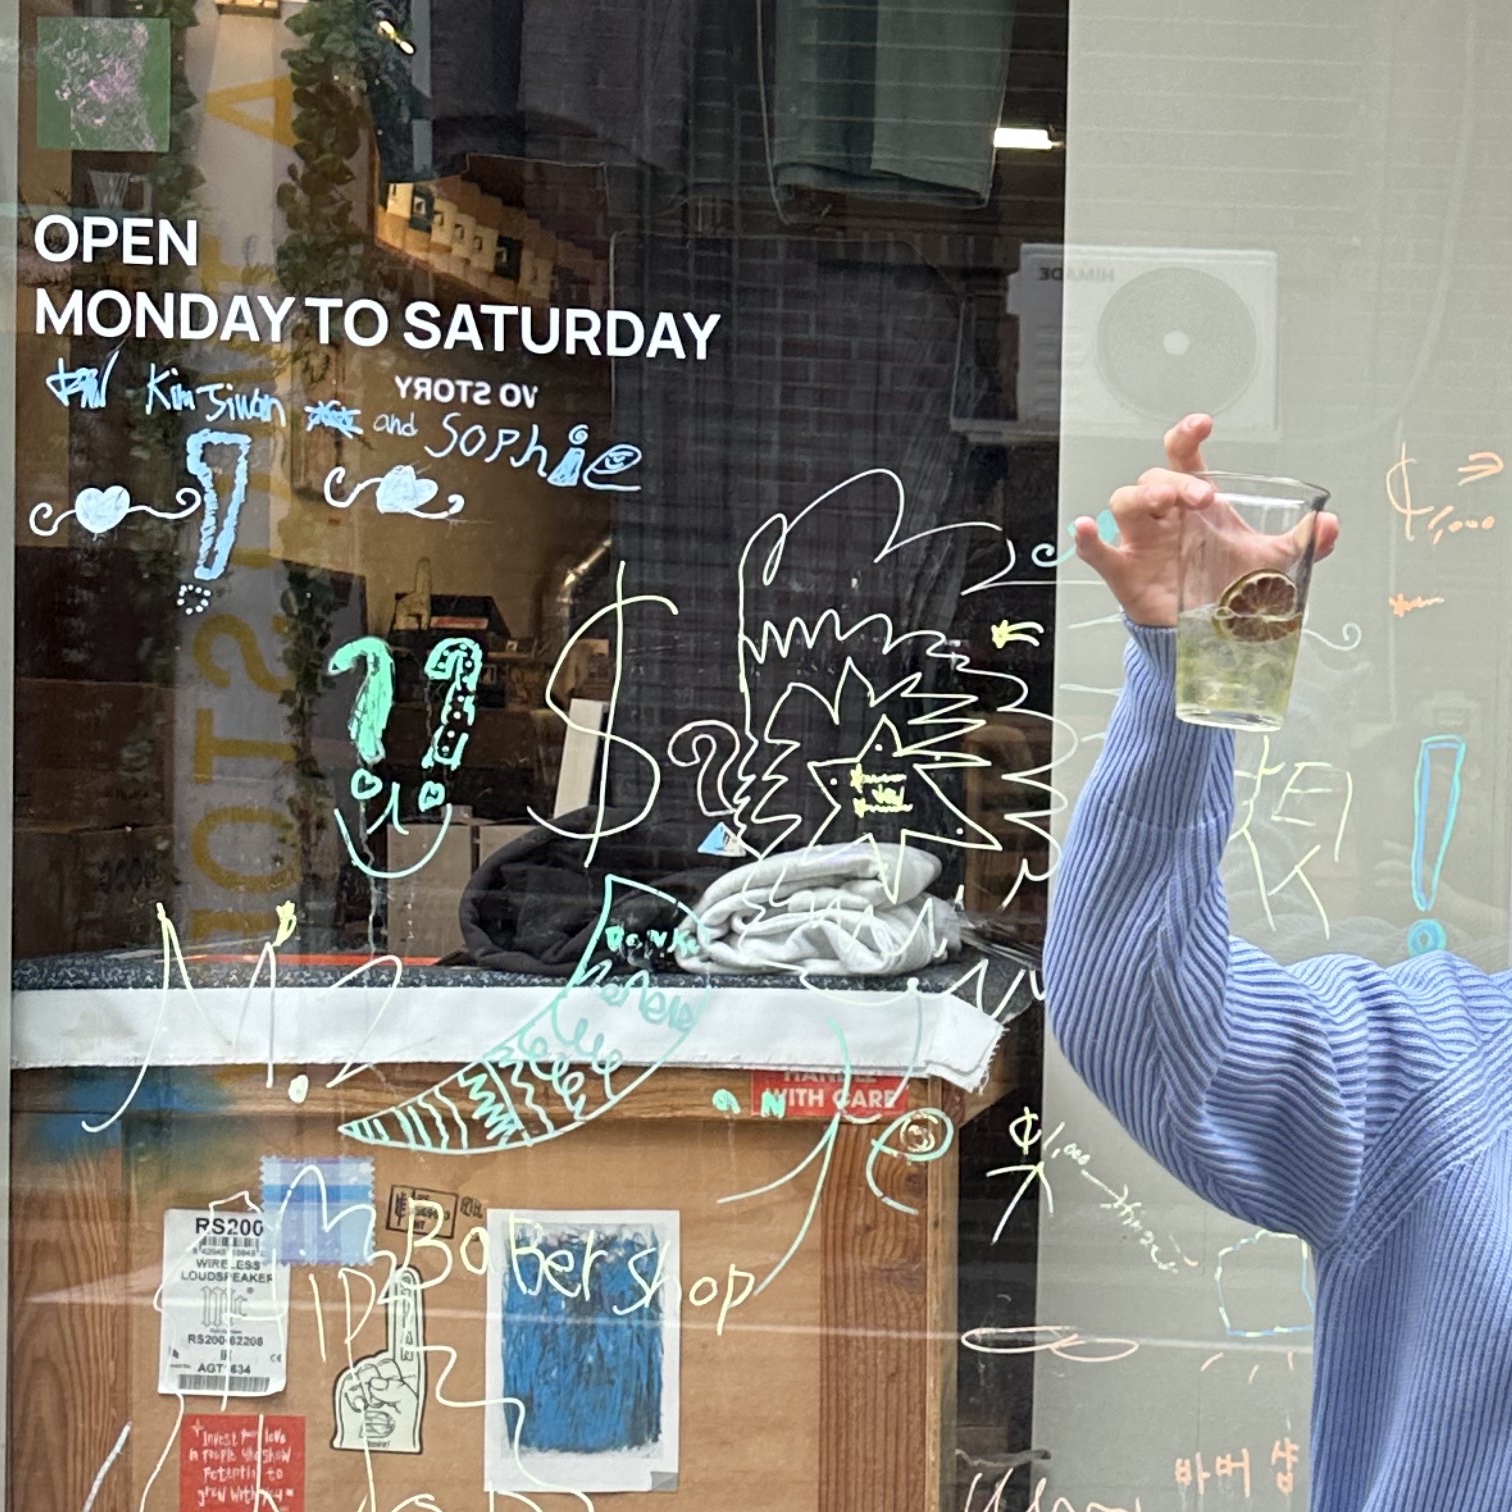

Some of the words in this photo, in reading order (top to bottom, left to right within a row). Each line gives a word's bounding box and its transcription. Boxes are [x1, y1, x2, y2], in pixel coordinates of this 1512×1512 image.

[34, 214, 198, 266] OPEN
[35, 288, 295, 343] MONDAY
[305, 297, 388, 347] TO
[403, 301, 721, 360] SATURDAY
[373, 412, 418, 437] and
[195, 1217, 264, 1236] RS200
